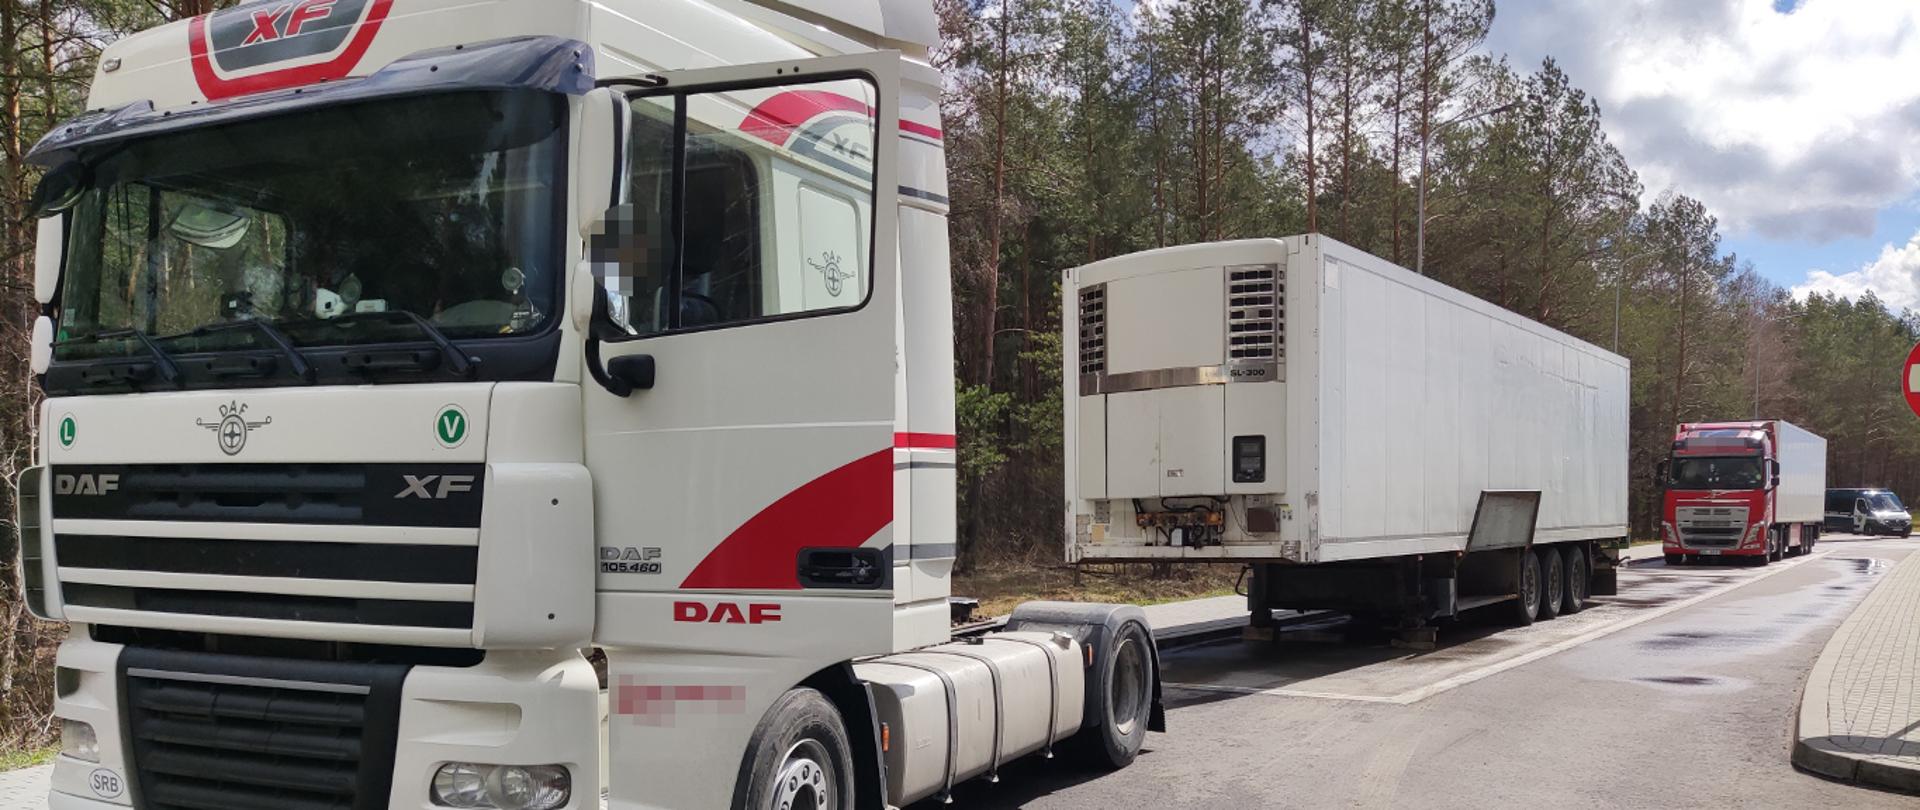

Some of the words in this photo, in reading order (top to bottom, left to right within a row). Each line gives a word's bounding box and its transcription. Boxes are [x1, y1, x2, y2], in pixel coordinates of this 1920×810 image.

[240, 0, 338, 47] XF
[219, 400, 248, 417] DAF
[64, 421, 73, 440] L
[443, 415, 460, 438] V
[55, 474, 120, 495] DAF
[393, 475, 475, 498] XF
[600, 547, 661, 560] DAF
[673, 601, 782, 624] DAF
[94, 774, 119, 792] SRB
